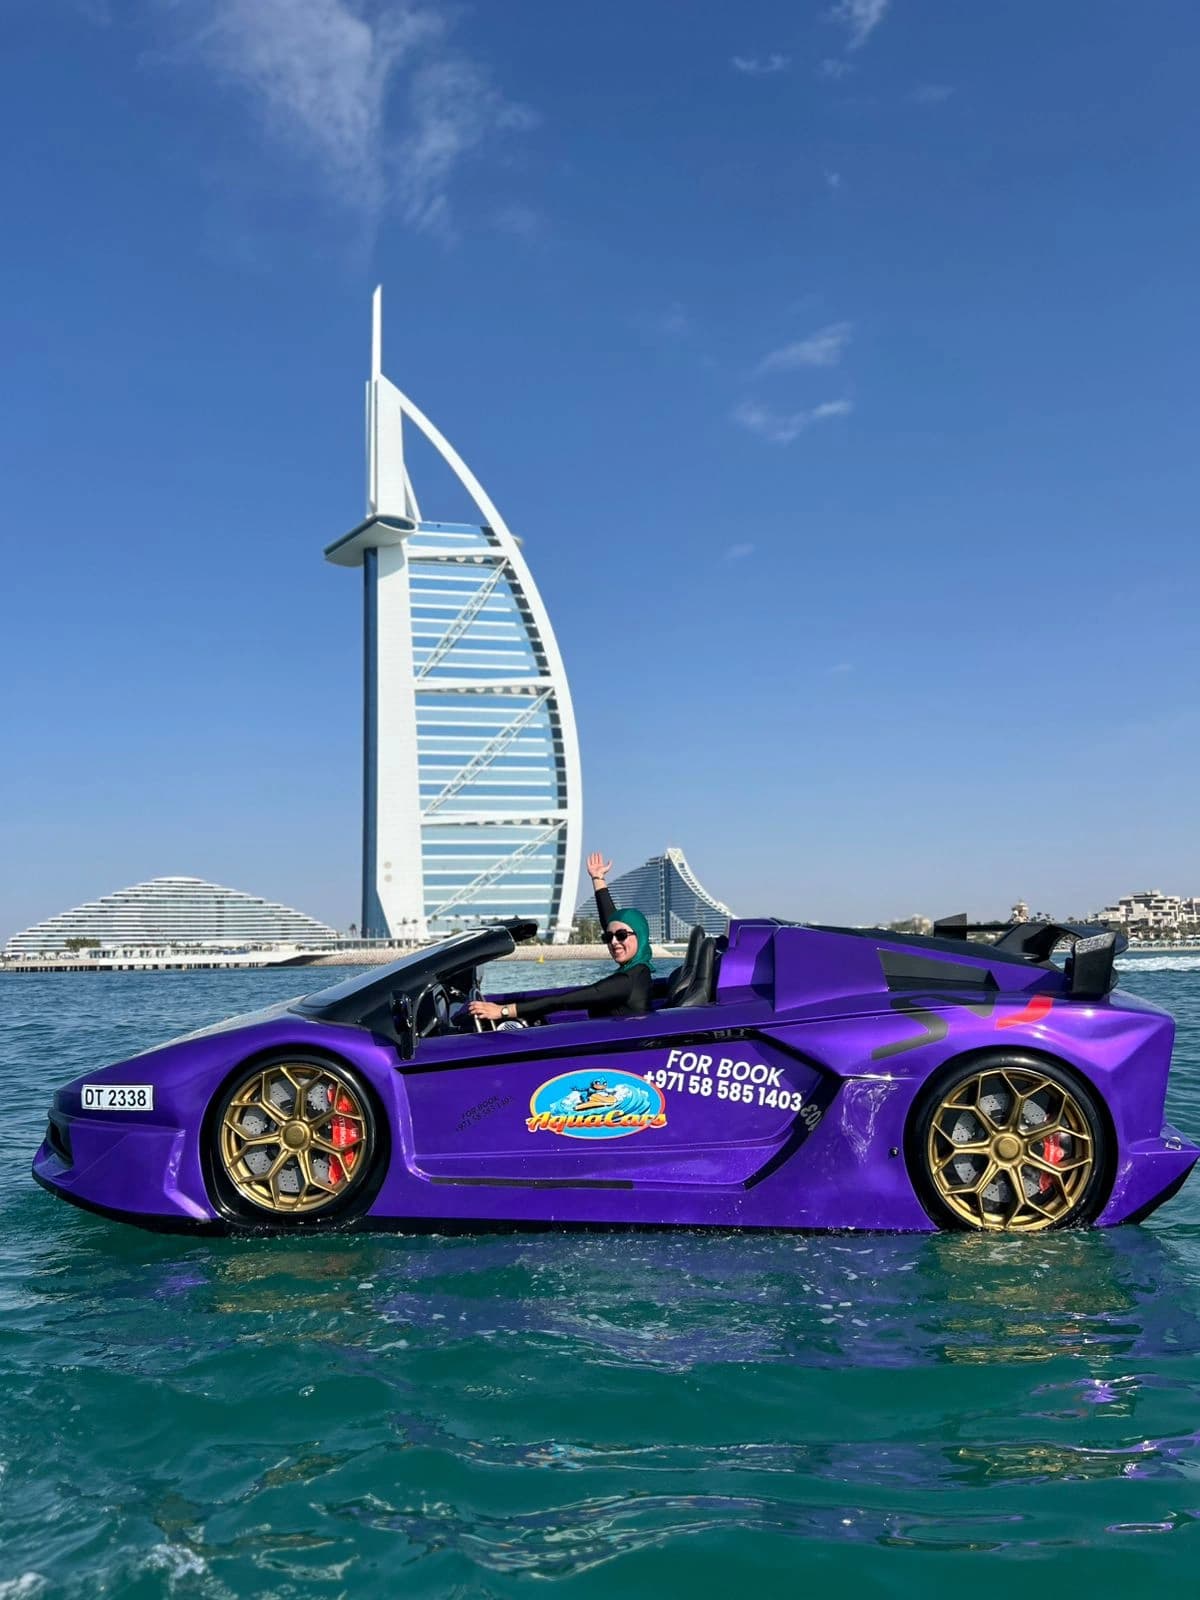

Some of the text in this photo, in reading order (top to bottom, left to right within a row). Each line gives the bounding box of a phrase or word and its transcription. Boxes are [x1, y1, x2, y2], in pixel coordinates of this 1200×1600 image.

[666, 1049, 785, 1088] FOR BOOK
[85, 1088, 147, 1107] DT 2338
[643, 1069, 802, 1112] +971 58 585 1403
[525, 1110, 668, 1134] AquaCars
